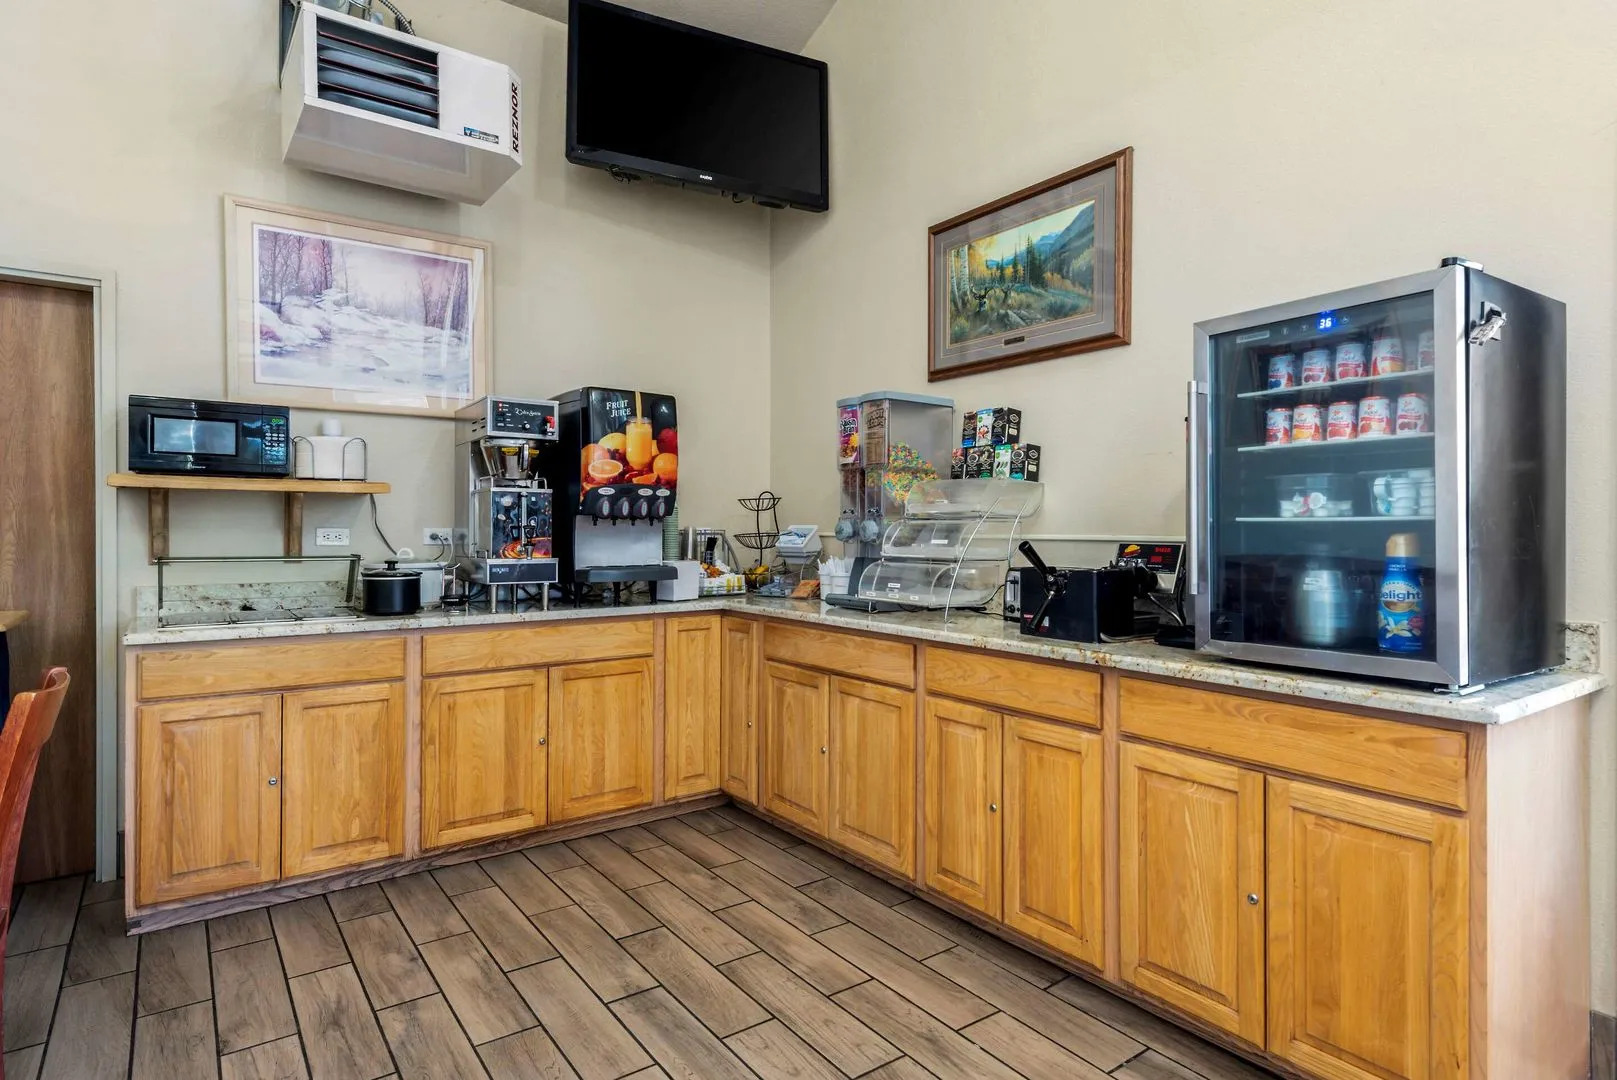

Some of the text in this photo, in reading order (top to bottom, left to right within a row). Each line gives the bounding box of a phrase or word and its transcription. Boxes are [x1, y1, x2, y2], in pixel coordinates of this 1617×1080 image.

[1320, 318, 1332, 329] 36
[606, 400, 628, 410] FRUIT
[610, 408, 632, 418] JUICE
[1378, 590, 1422, 602] elight
